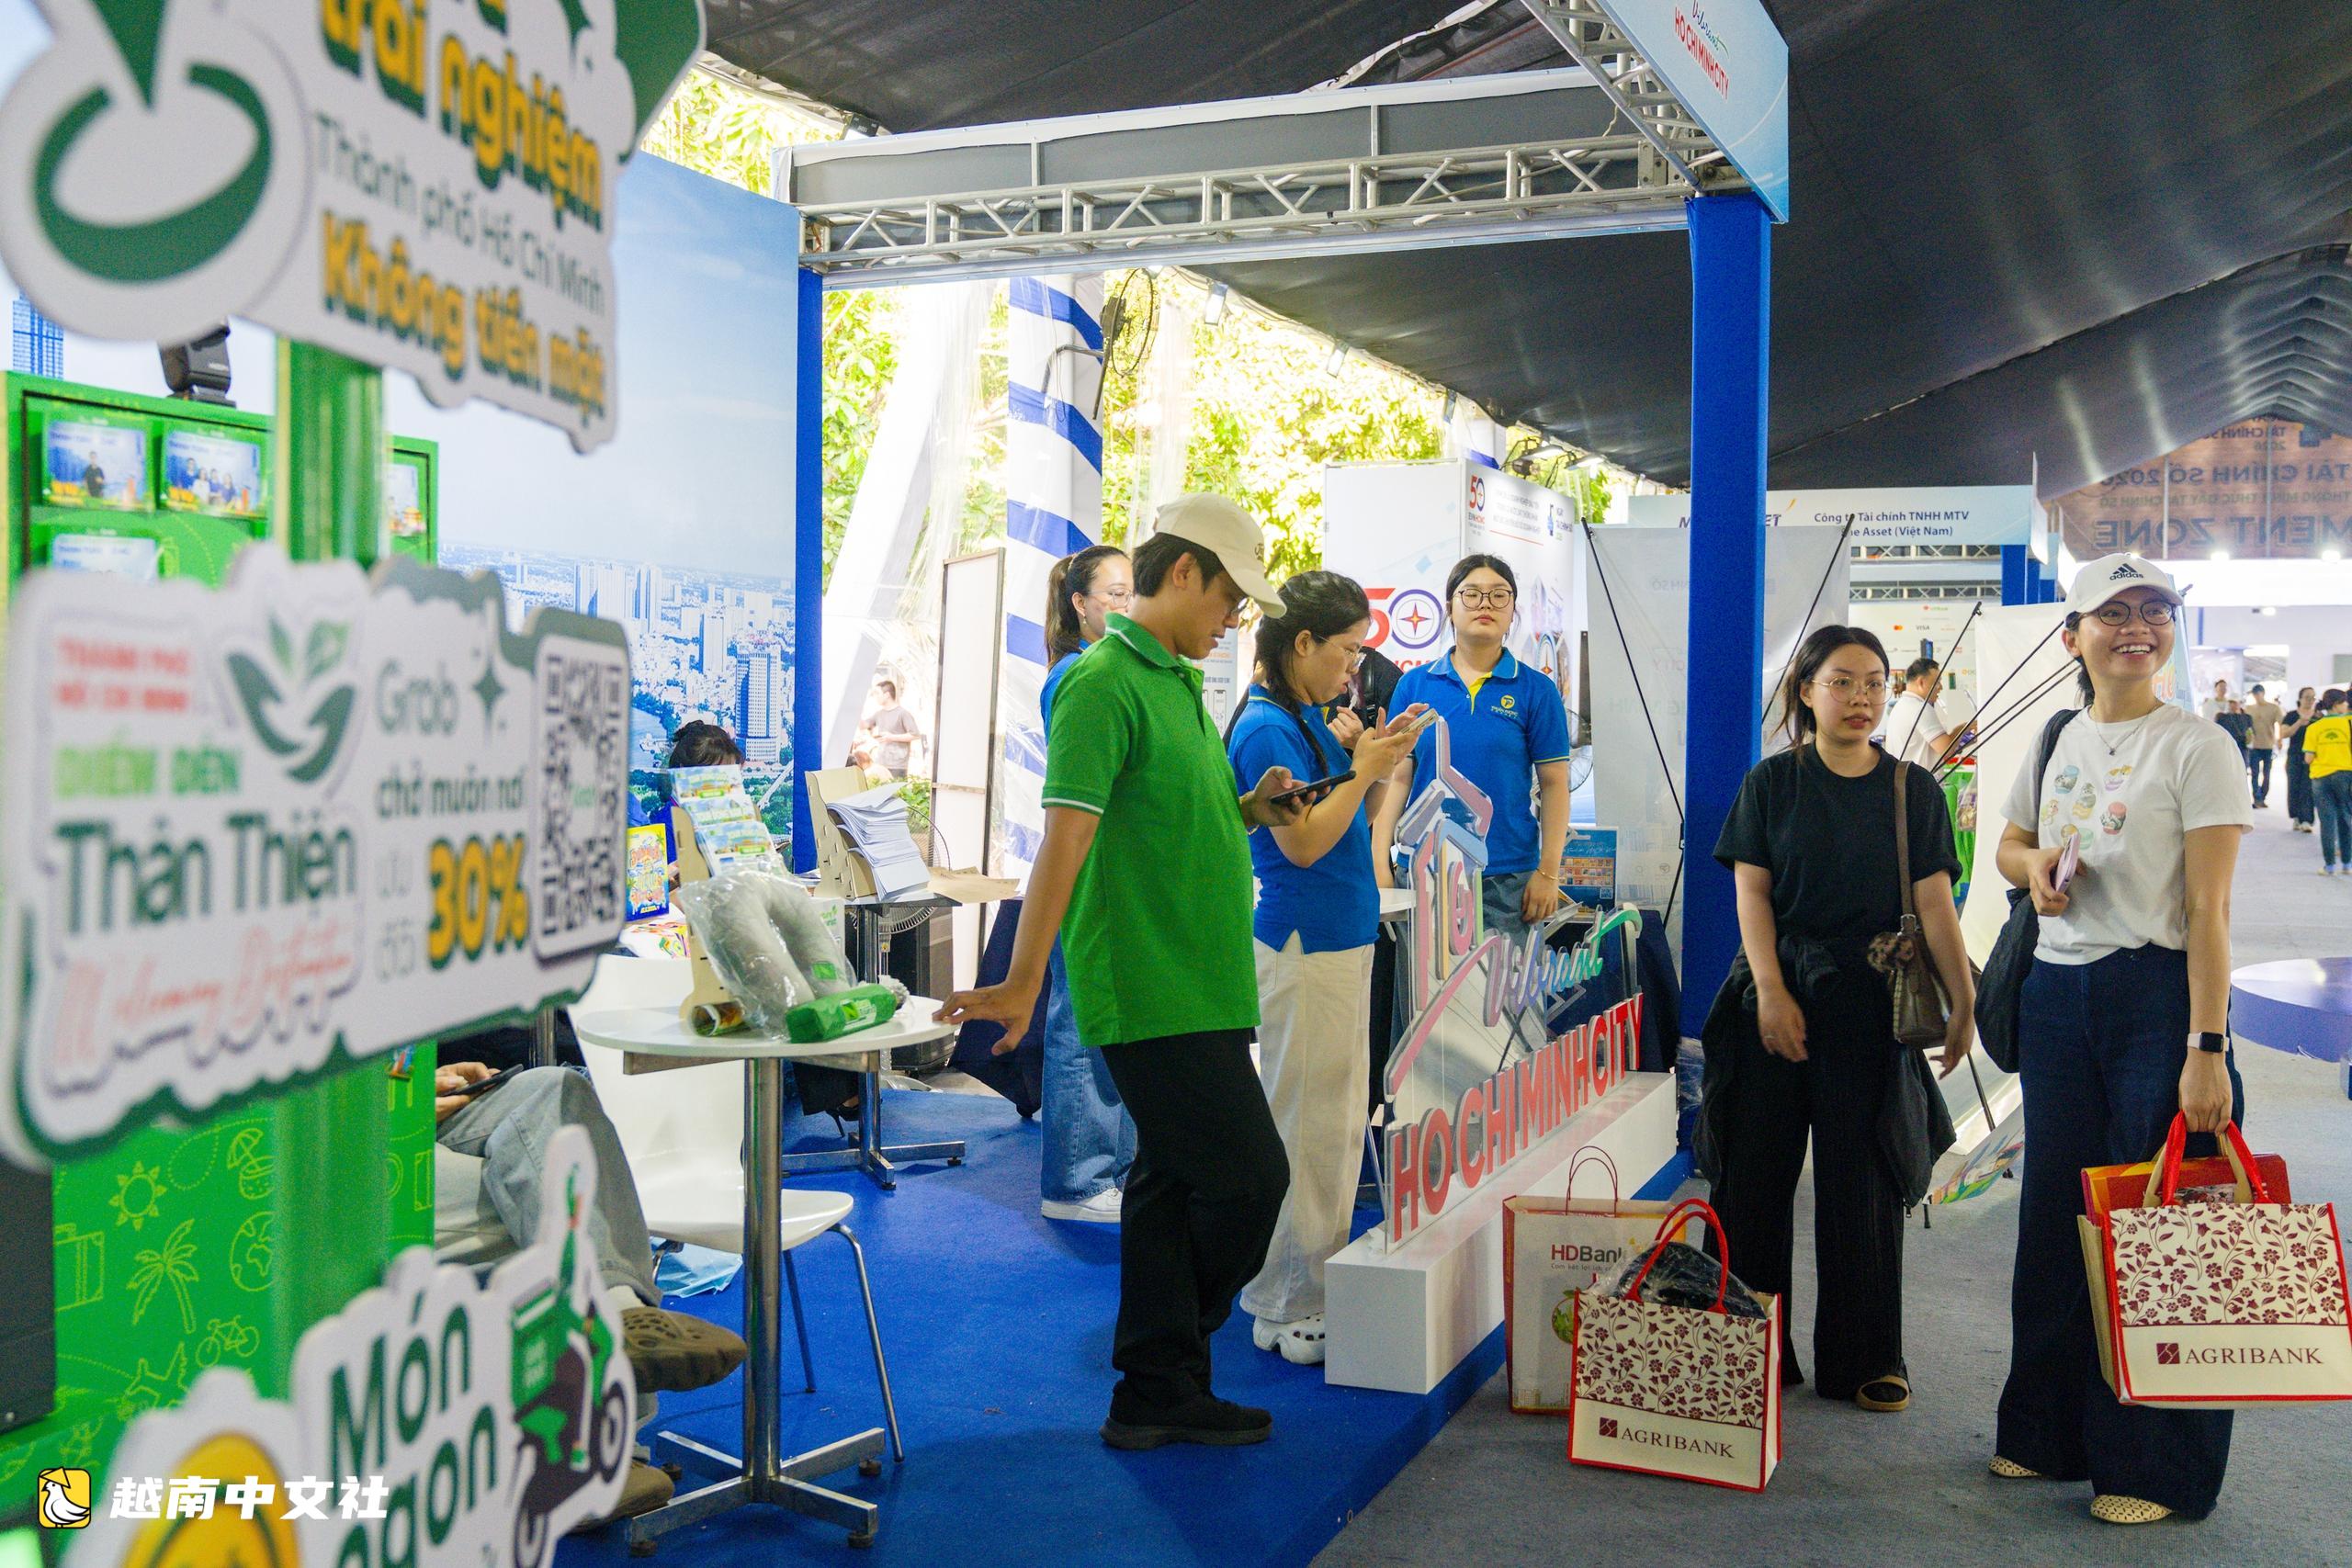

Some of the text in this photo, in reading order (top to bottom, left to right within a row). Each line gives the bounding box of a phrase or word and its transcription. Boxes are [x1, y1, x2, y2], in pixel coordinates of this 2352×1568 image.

[1675, 6, 1729, 100] HO CHI MINH CITY
[439, 33, 603, 232] nghiệm
[323, 209, 466, 381] Không
[1814, 512, 1842, 524] Công
[1859, 511, 1873, 521] Tài
[1908, 511, 1940, 521] TNHH
[1943, 511, 1970, 521] MTV
[1862, 526, 1892, 536] Asset
[1924, 526, 1953, 537] Nam)
[2109, 571, 2144, 581] adidas
[425, 830, 531, 972] 30%
[1387, 992, 1645, 1244] HO CHI MINH CITY
[328, 1284, 471, 1512] Món
[2185, 1347, 2324, 1364] AGRIBANK
[1621, 1427, 1735, 1459] AGRIBANK
